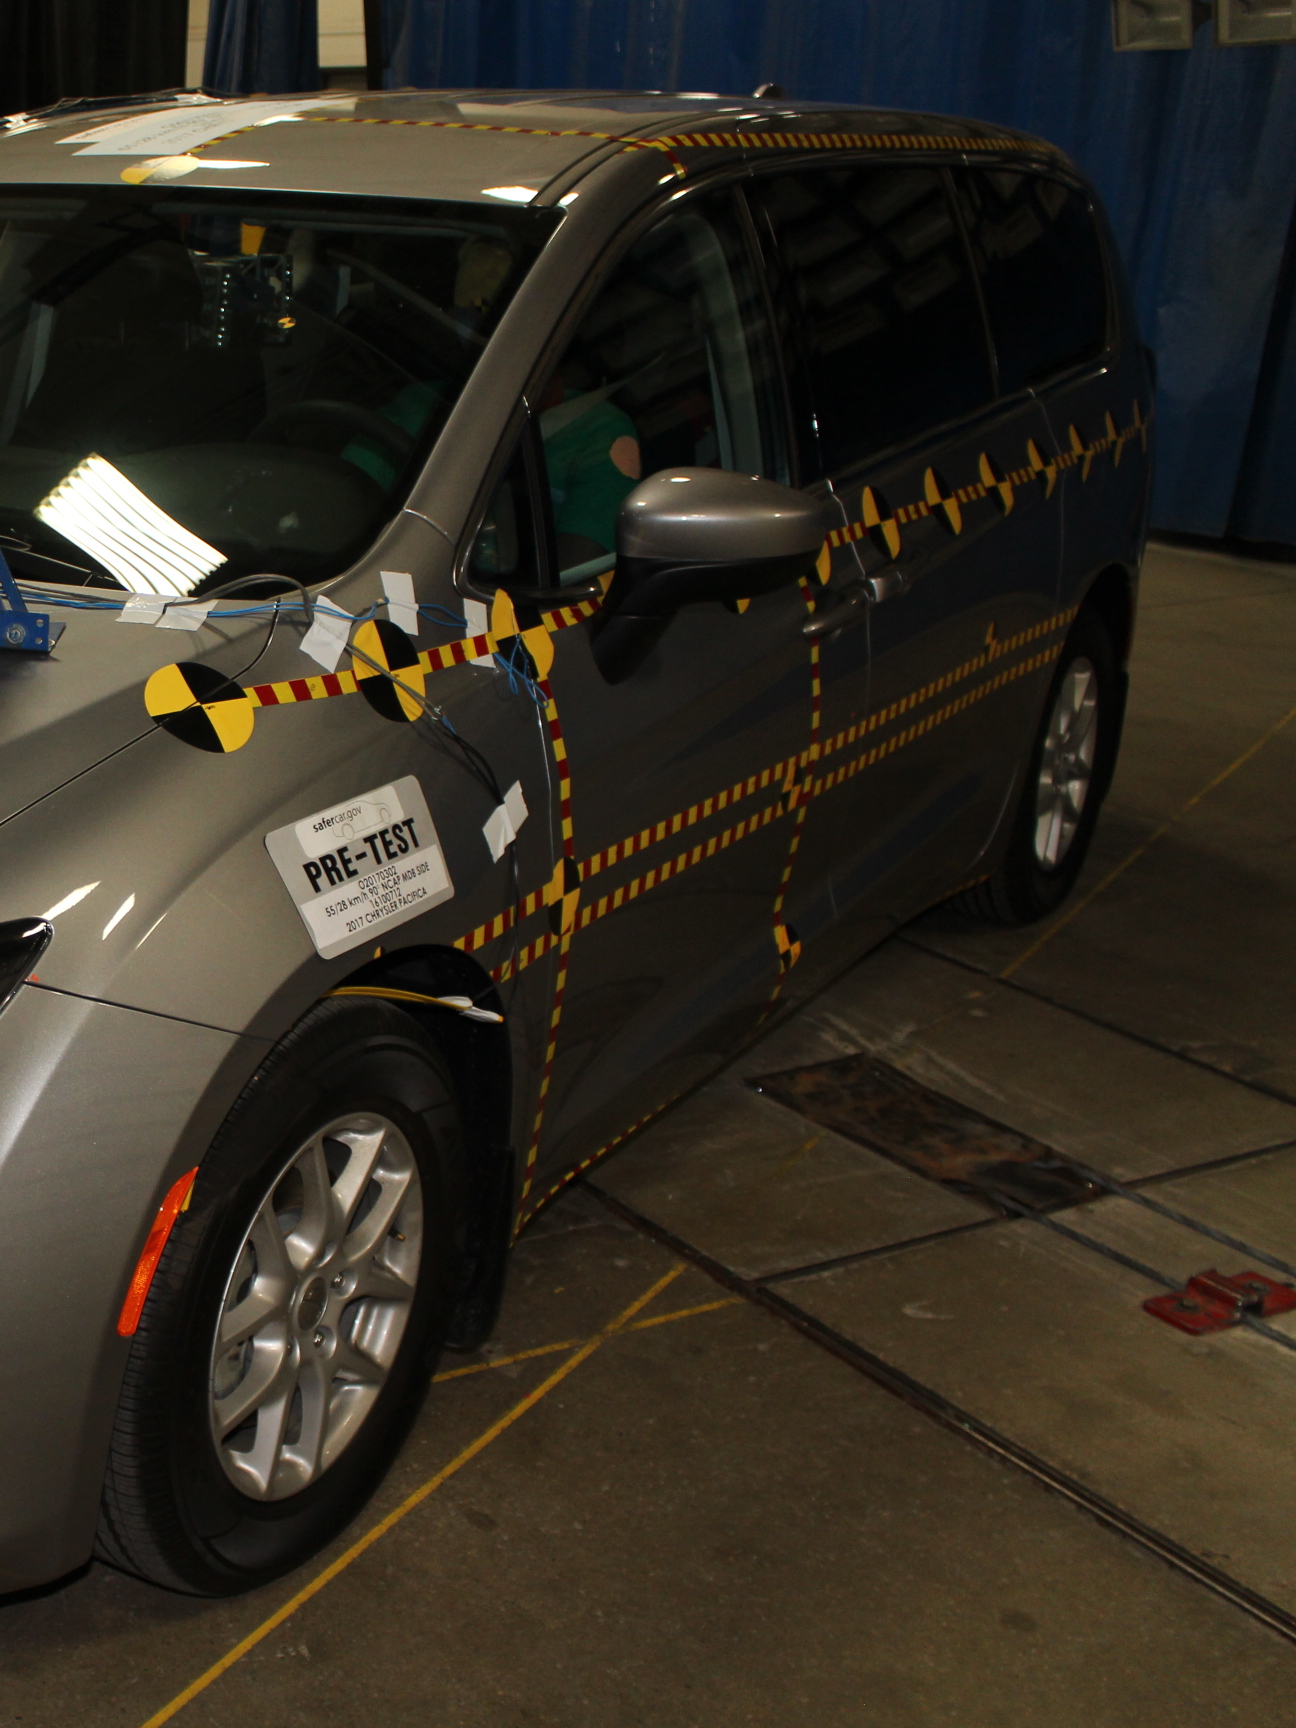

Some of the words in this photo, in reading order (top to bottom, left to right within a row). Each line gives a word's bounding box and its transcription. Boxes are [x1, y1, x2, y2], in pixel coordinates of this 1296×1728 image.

[312, 806, 362, 833] safercar.gov
[302, 818, 420, 893] PRE-TEST
[325, 900, 348, 918] 55/28
[347, 891, 369, 907] km/h
[381, 876, 401, 892] NCAP
[402, 868, 416, 883] MDB
[416, 861, 430, 876] SIDE
[346, 917, 364, 933] 2017
[365, 901, 397, 923] CHRYSLER
[398, 887, 428, 907] PACIFICA
[369, 887, 402, 908] 16100712
